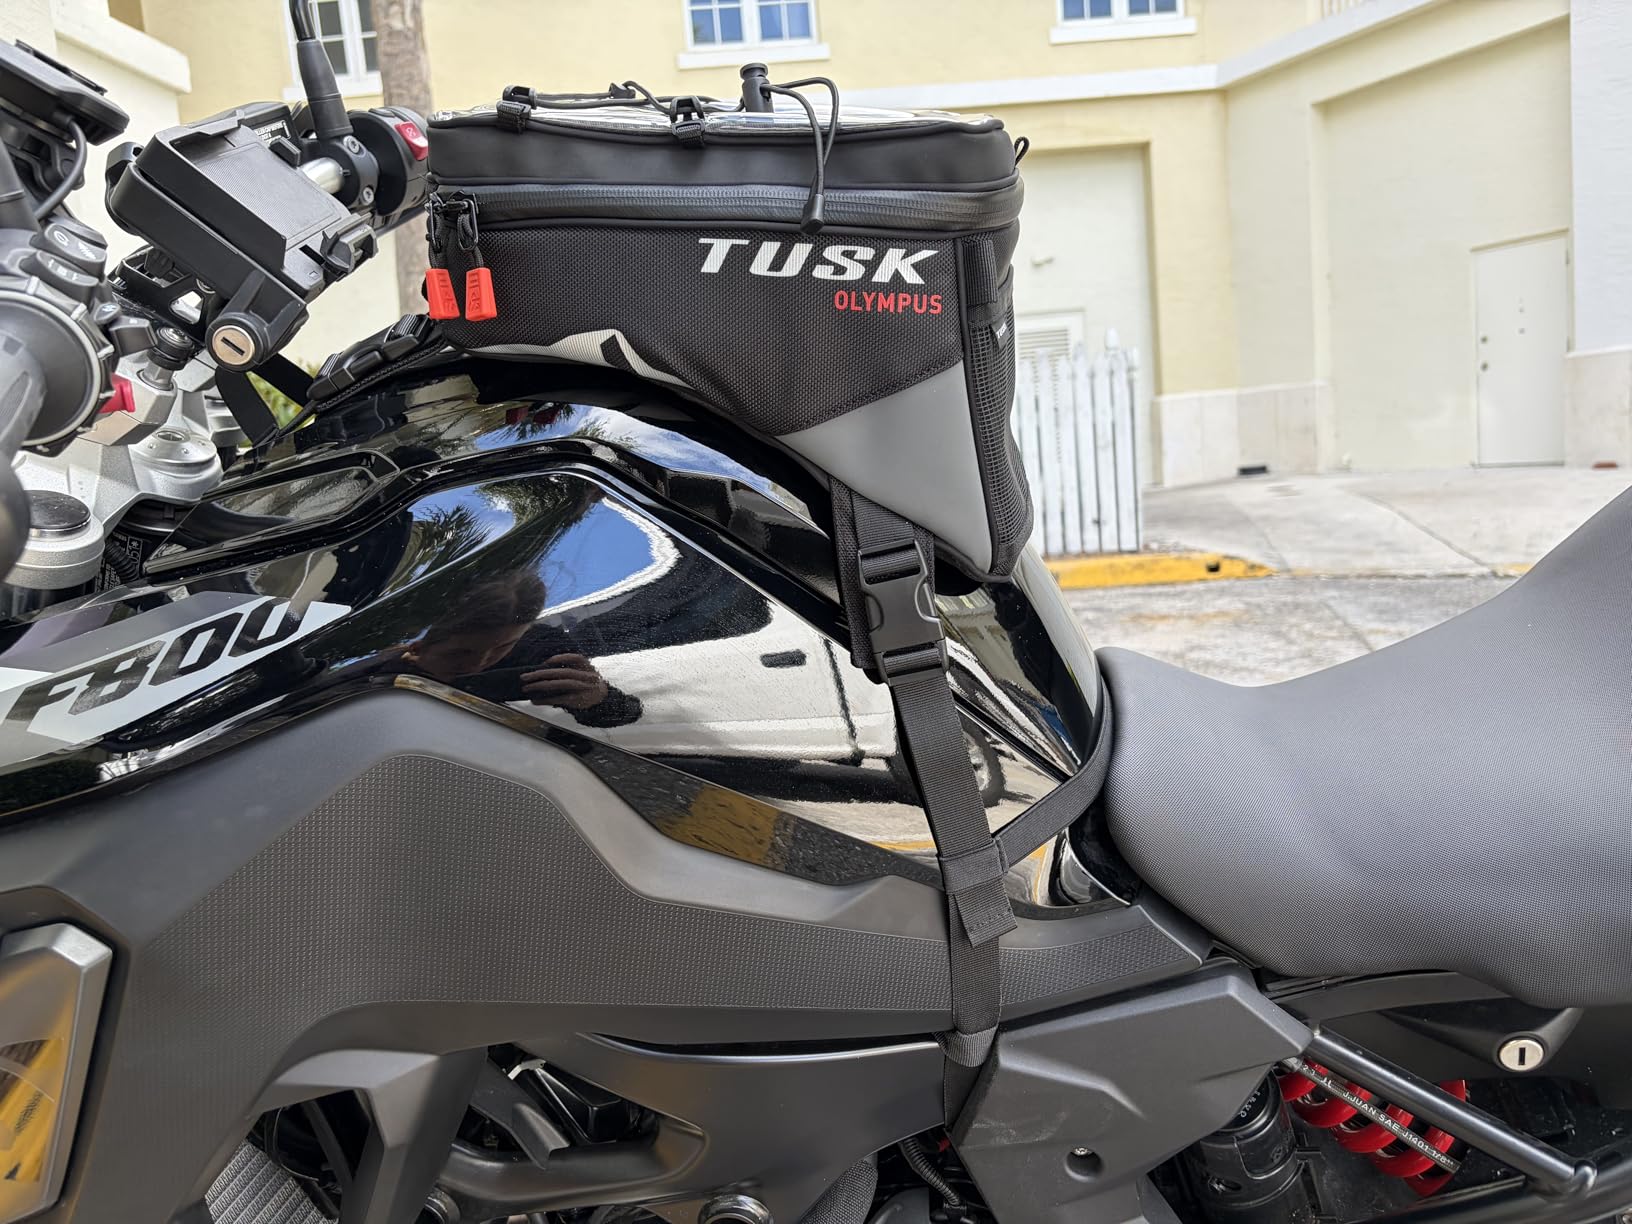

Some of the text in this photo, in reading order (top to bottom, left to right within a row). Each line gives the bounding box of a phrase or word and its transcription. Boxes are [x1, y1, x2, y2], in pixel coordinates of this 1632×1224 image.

[698, 237, 940, 285] TUSK
[834, 289, 943, 315] OLYMPUS
[1342, 1091, 1377, 1116] J.JUAN
[1379, 1113, 1400, 1132] SAE
